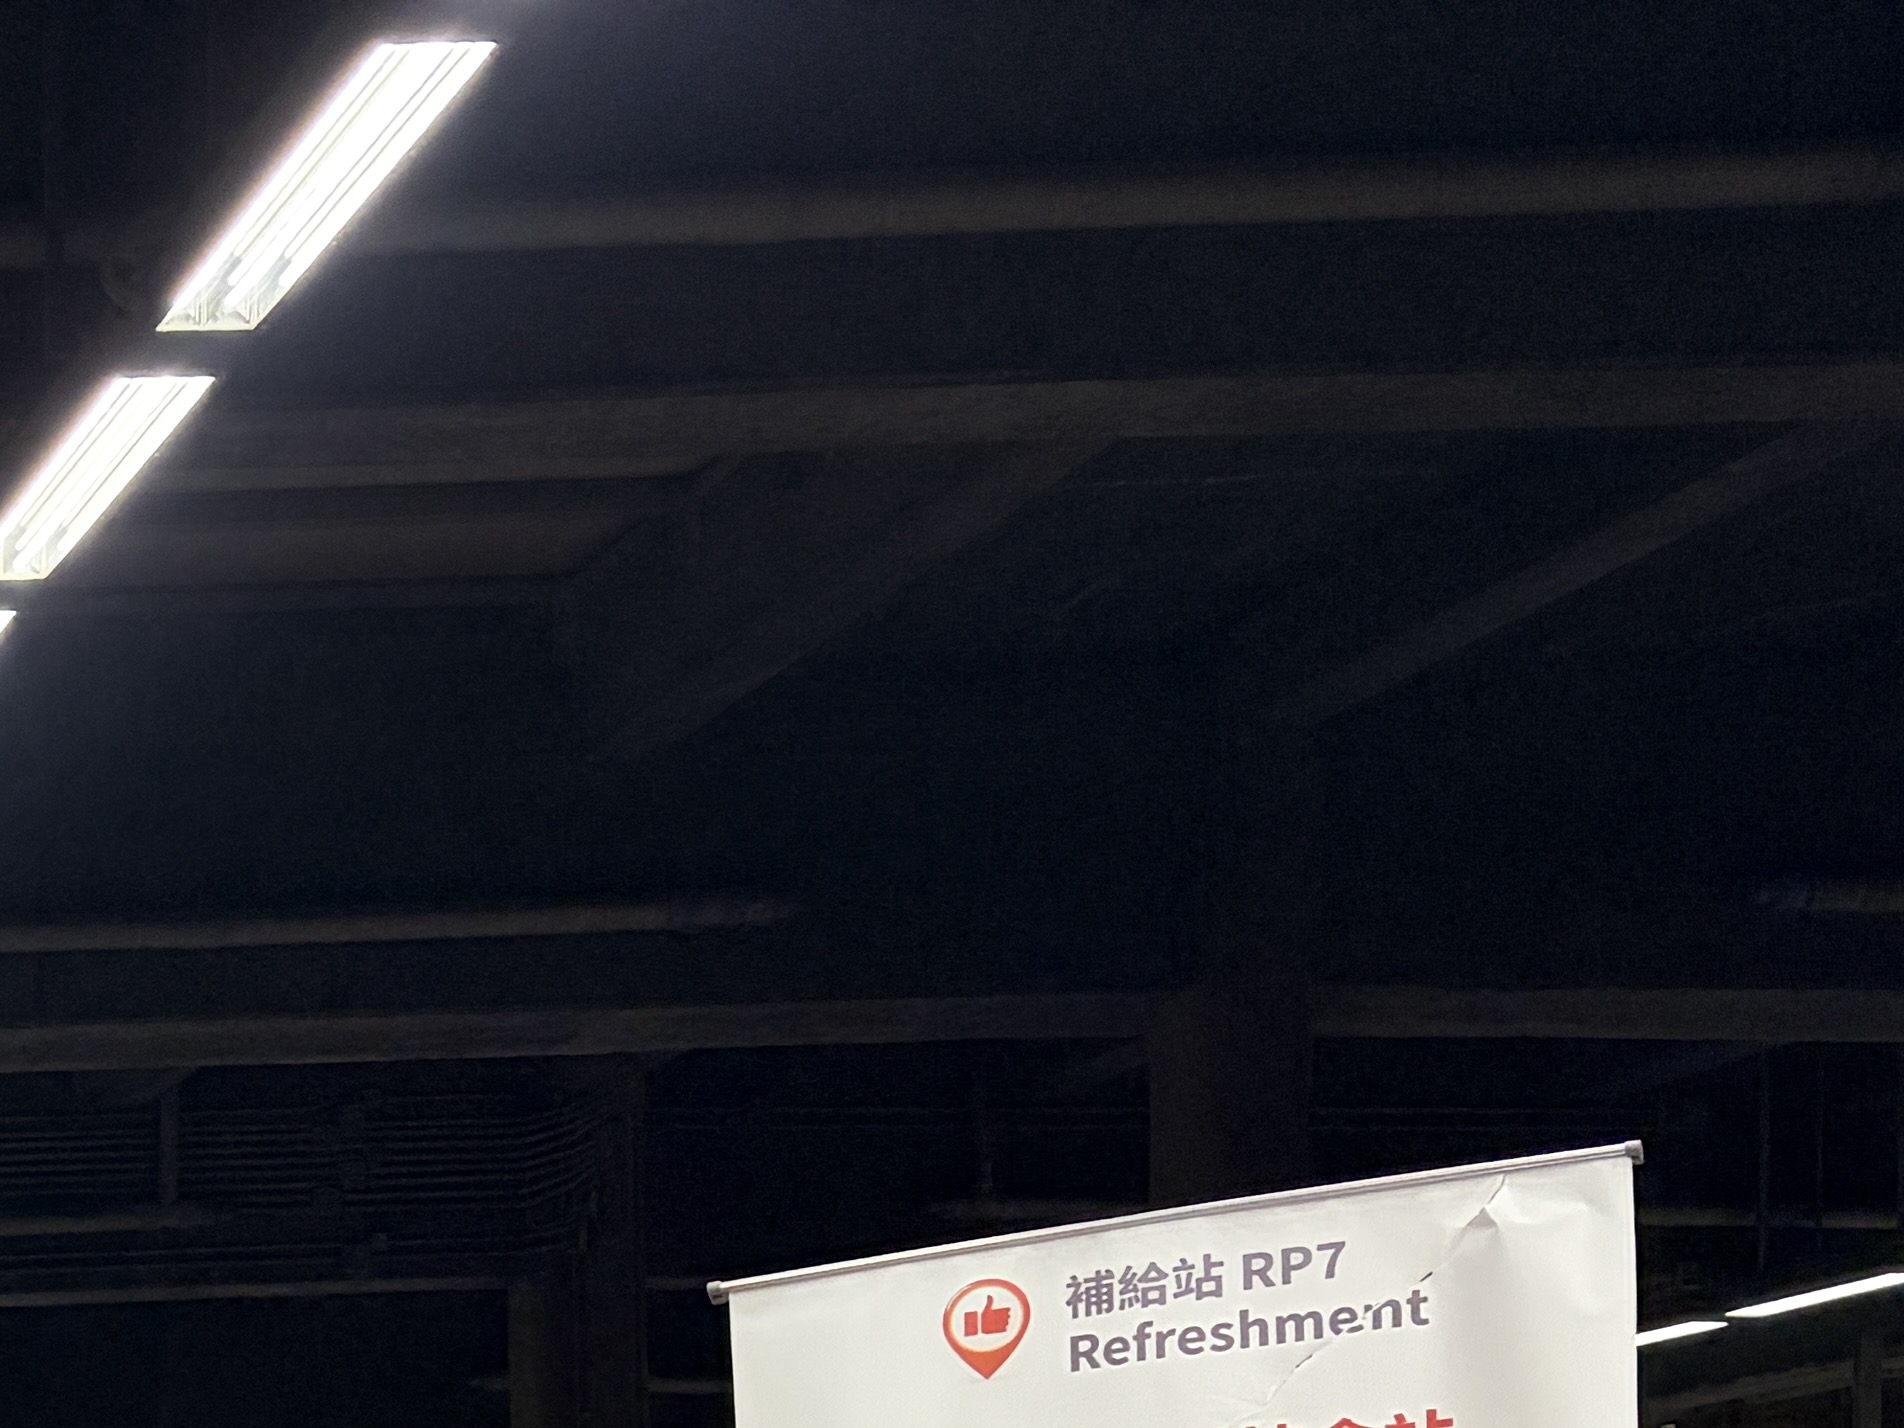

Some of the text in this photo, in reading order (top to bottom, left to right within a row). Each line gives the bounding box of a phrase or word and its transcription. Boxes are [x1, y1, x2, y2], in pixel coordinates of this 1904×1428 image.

[1065, 1241, 1347, 1320] 補給站 RP7
[1068, 1285, 1430, 1372] Refreshment
